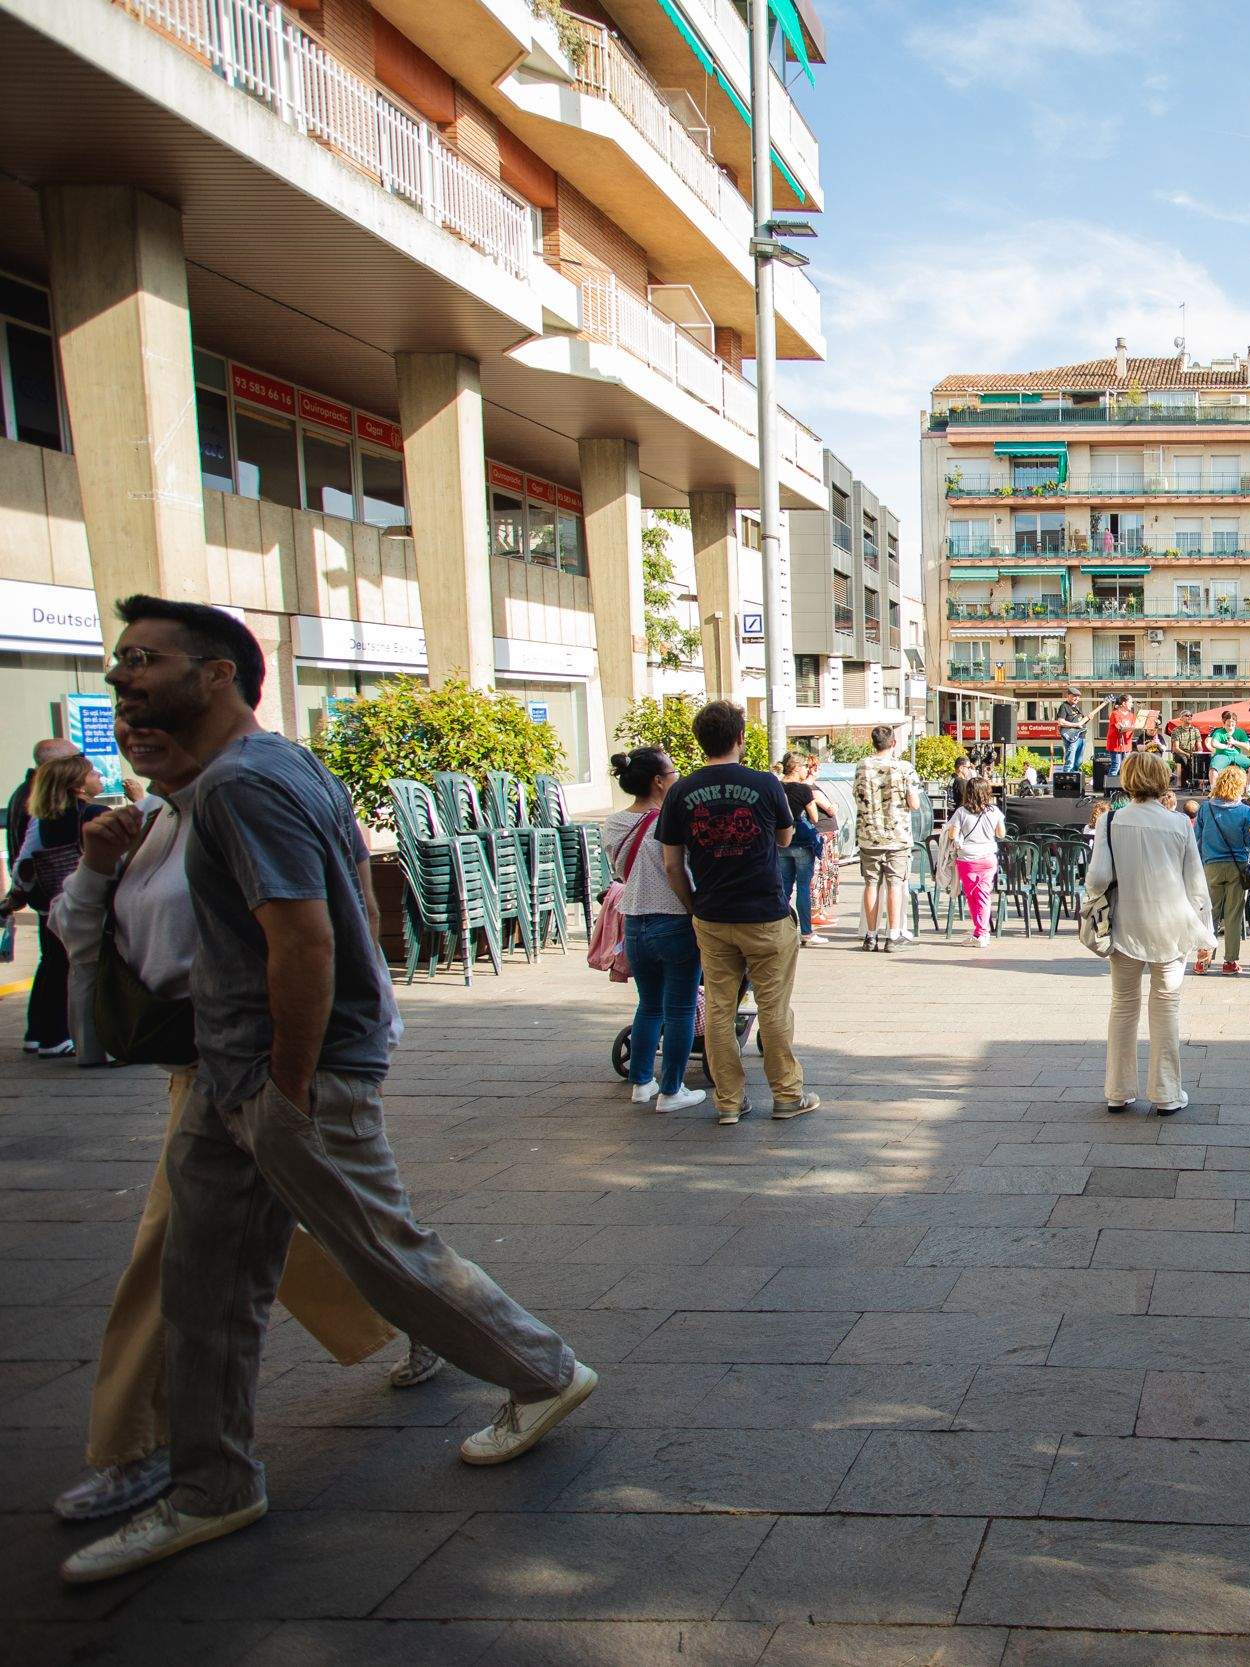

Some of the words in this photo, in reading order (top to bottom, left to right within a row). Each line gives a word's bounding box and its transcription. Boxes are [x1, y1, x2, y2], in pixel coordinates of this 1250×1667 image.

[235, 376, 247, 389] 93
[249, 381, 265, 396] 583
[267, 387, 279, 399] 66
[281, 392, 292, 405] 16
[33, 607, 101, 628] Deutsch
[683, 785, 721, 810] JUNK
[724, 784, 759, 804] FOOD
